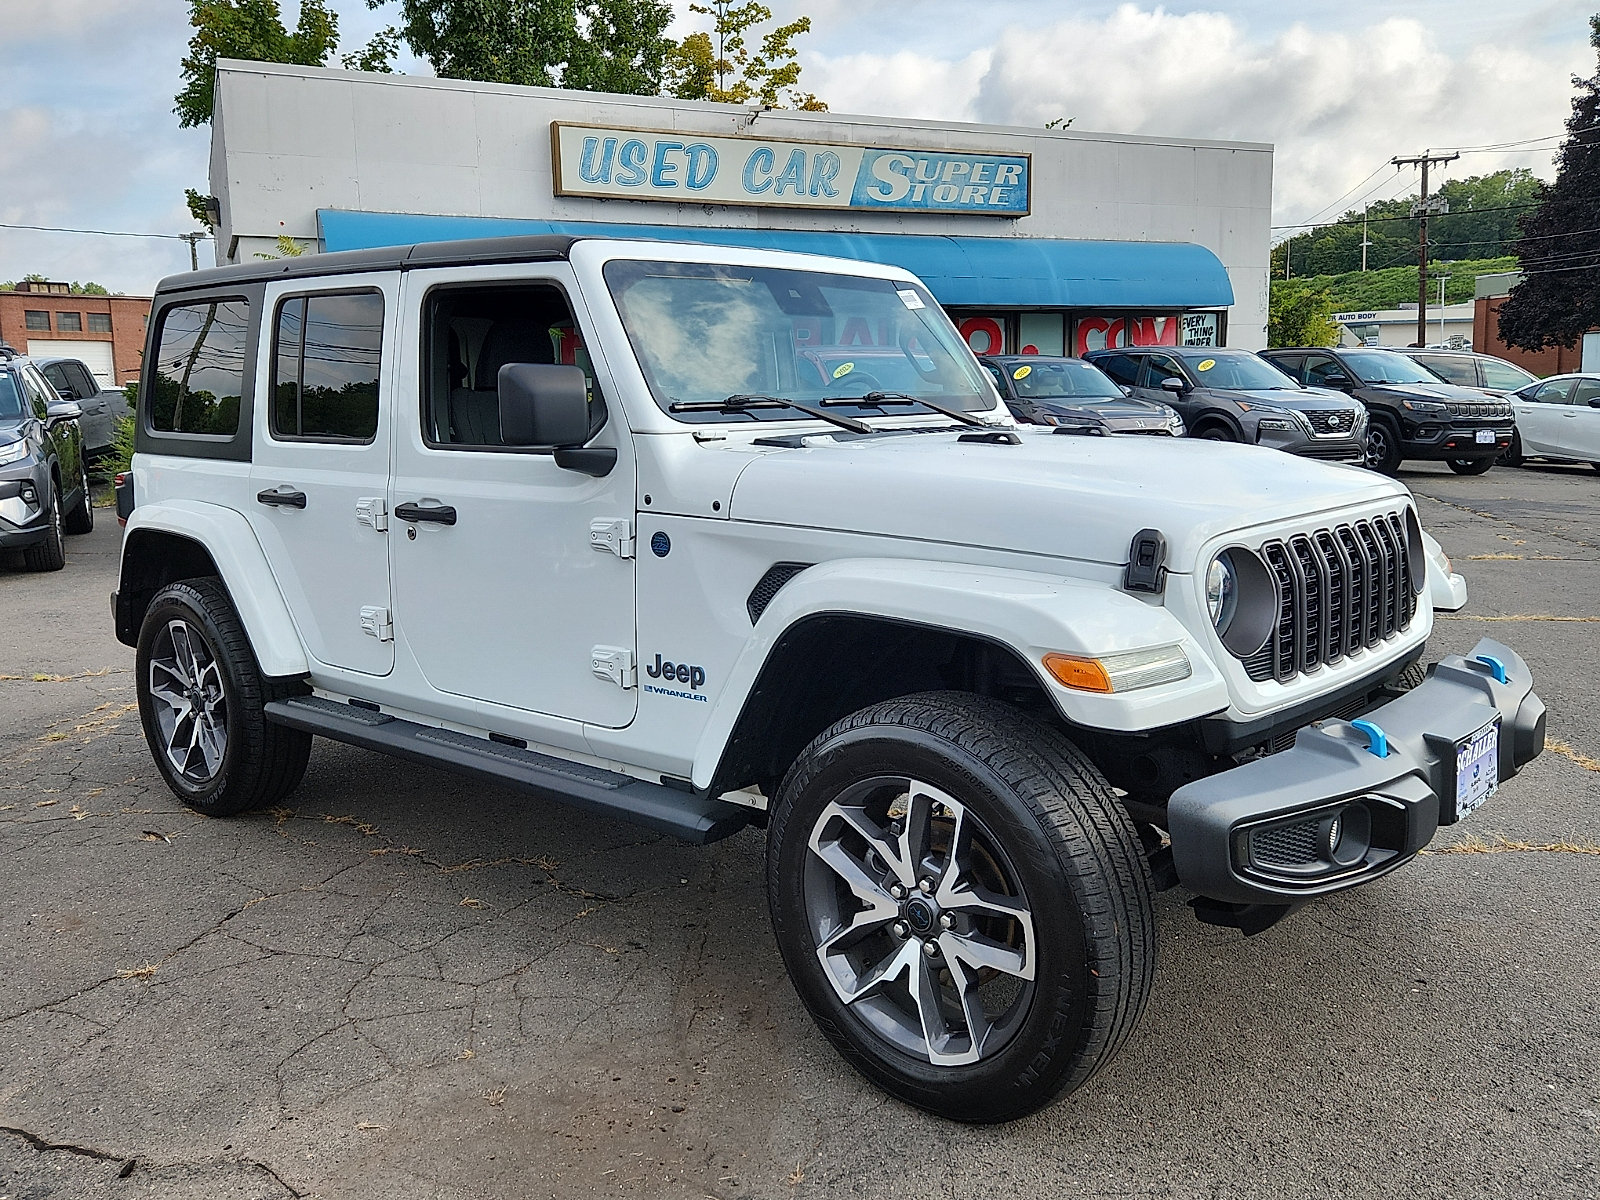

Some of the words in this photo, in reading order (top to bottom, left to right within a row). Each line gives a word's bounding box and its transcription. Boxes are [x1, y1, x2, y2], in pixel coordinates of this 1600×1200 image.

[579, 136, 719, 190] USED
[742, 146, 841, 198] CAR
[867, 154, 1023, 202] SUPER
[1183, 315, 1207, 329] EVERY
[1188, 326, 1214, 338] THING
[646, 653, 706, 691] Jeep
[653, 686, 708, 702] WRANGLER
[1456, 731, 1498, 775] SCHALLER
